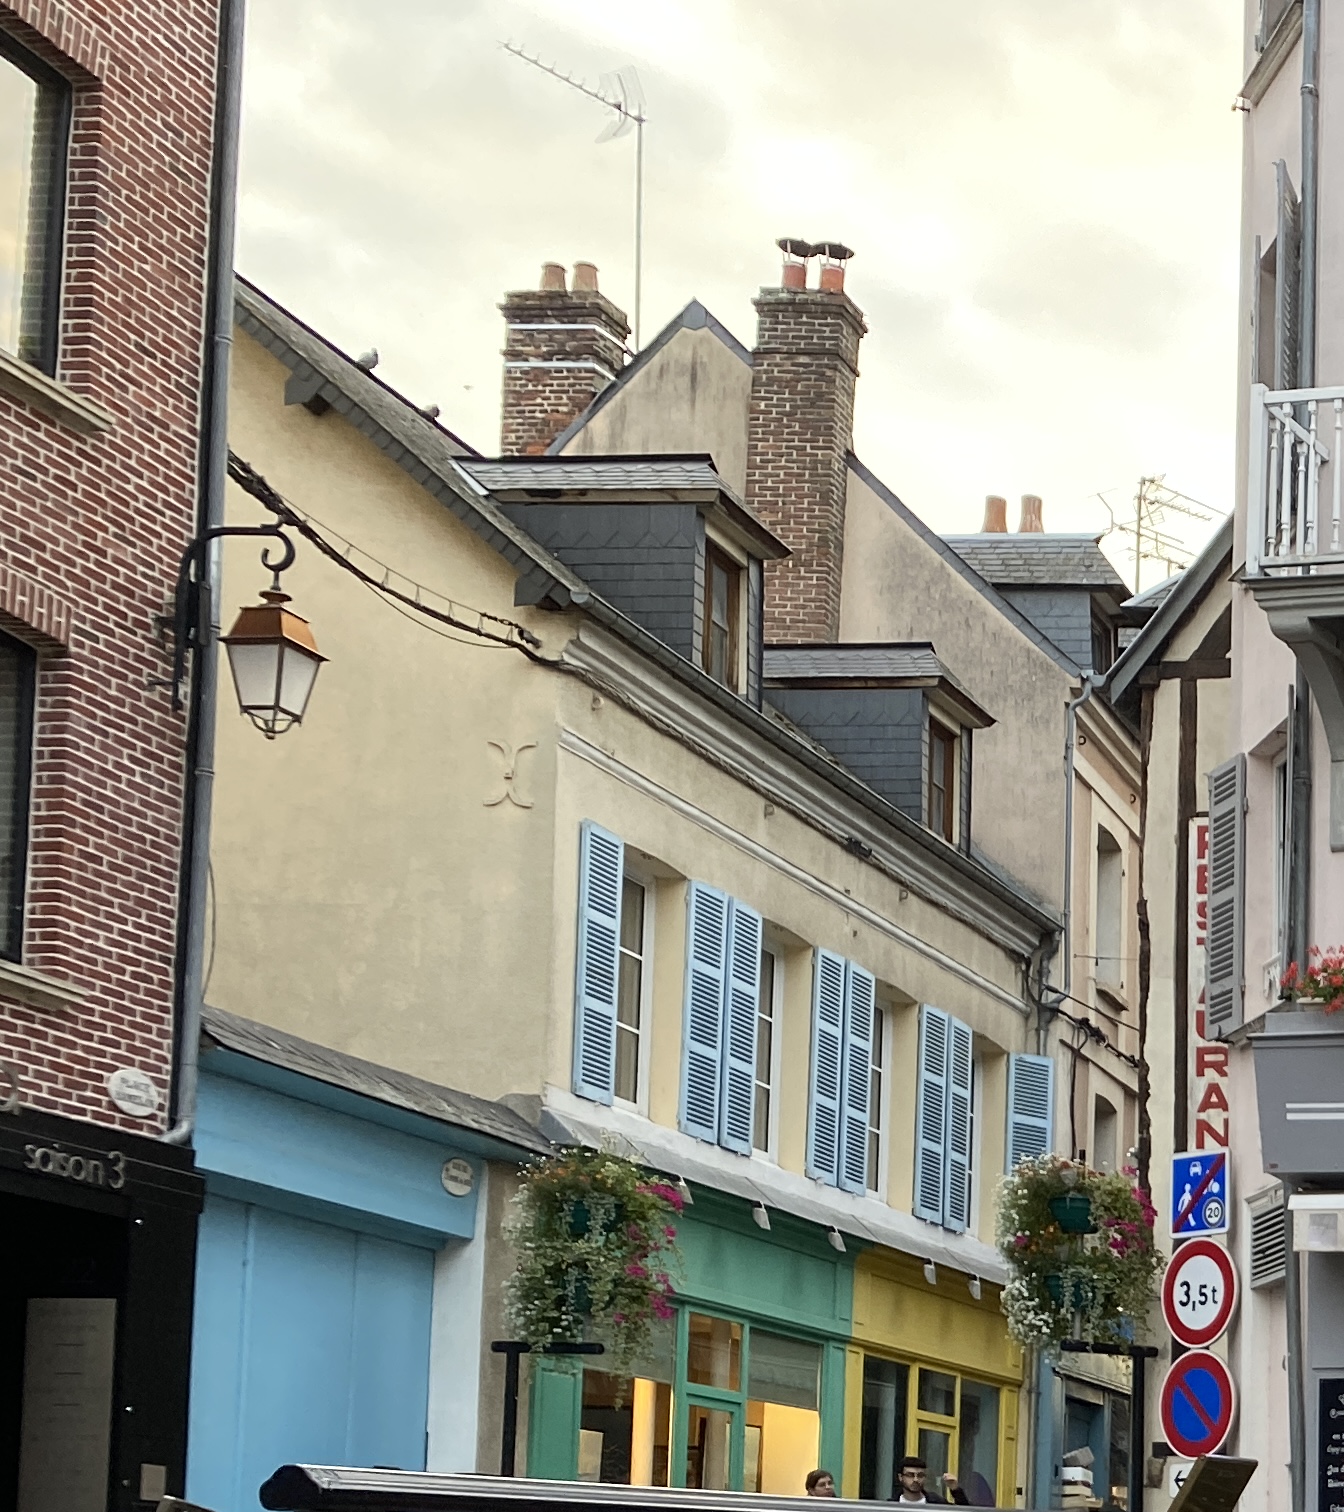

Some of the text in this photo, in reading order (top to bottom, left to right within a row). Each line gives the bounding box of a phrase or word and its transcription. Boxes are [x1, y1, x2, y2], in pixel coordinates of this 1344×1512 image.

[24, 1144, 125, 1189] saison 3
[1207, 1207, 1219, 1219] 20
